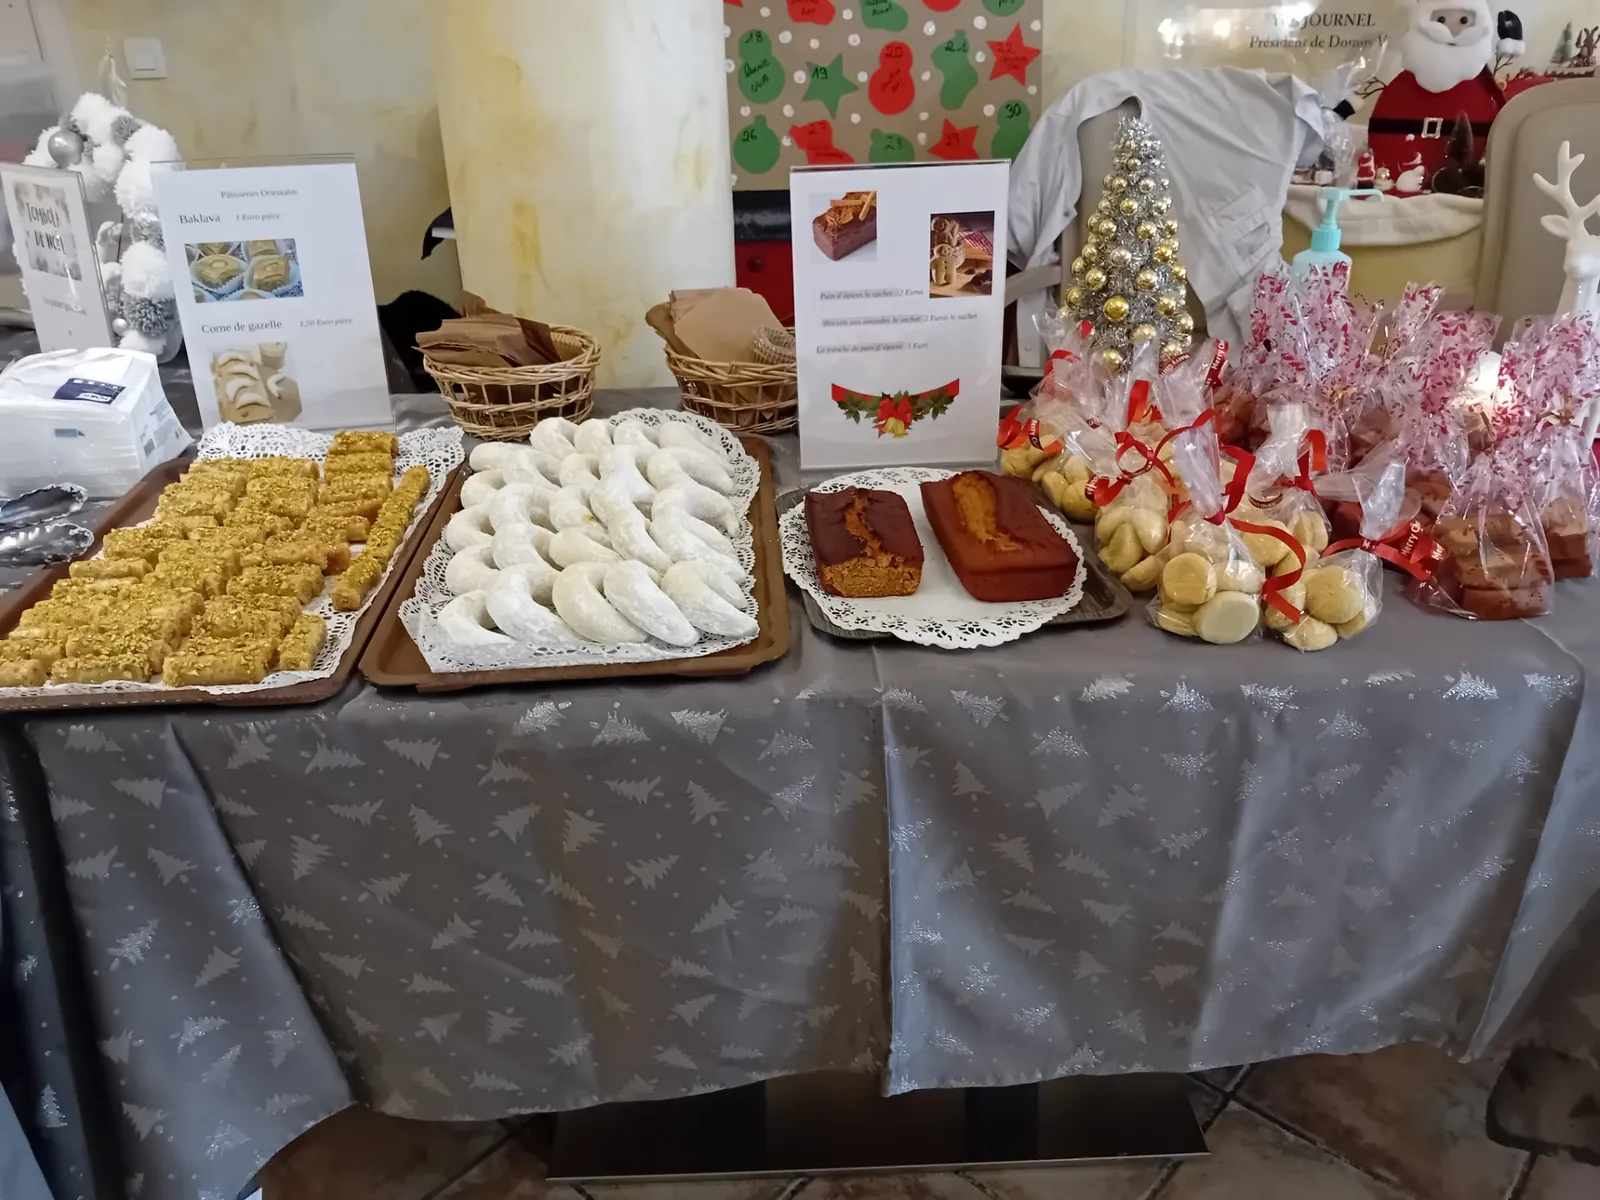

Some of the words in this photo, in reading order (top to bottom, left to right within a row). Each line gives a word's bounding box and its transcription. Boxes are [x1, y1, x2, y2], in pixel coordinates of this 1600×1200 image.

[1300, 13, 1376, 29] JOURNEL
[745, 31, 763, 44] 18
[1250, 35, 1306, 48] Président
[1310, 35, 1325, 48] de
[885, 46, 903, 58] 20
[945, 40, 968, 53] 21
[811, 67, 828, 80] 19
[1005, 103, 1022, 119] 30
[741, 128, 757, 142] 26
[179, 213, 221, 224] Baklava
[234, 321, 245, 331] de
[249, 319, 283, 332] gazelle
[1401, 533, 1419, 556] Merry
